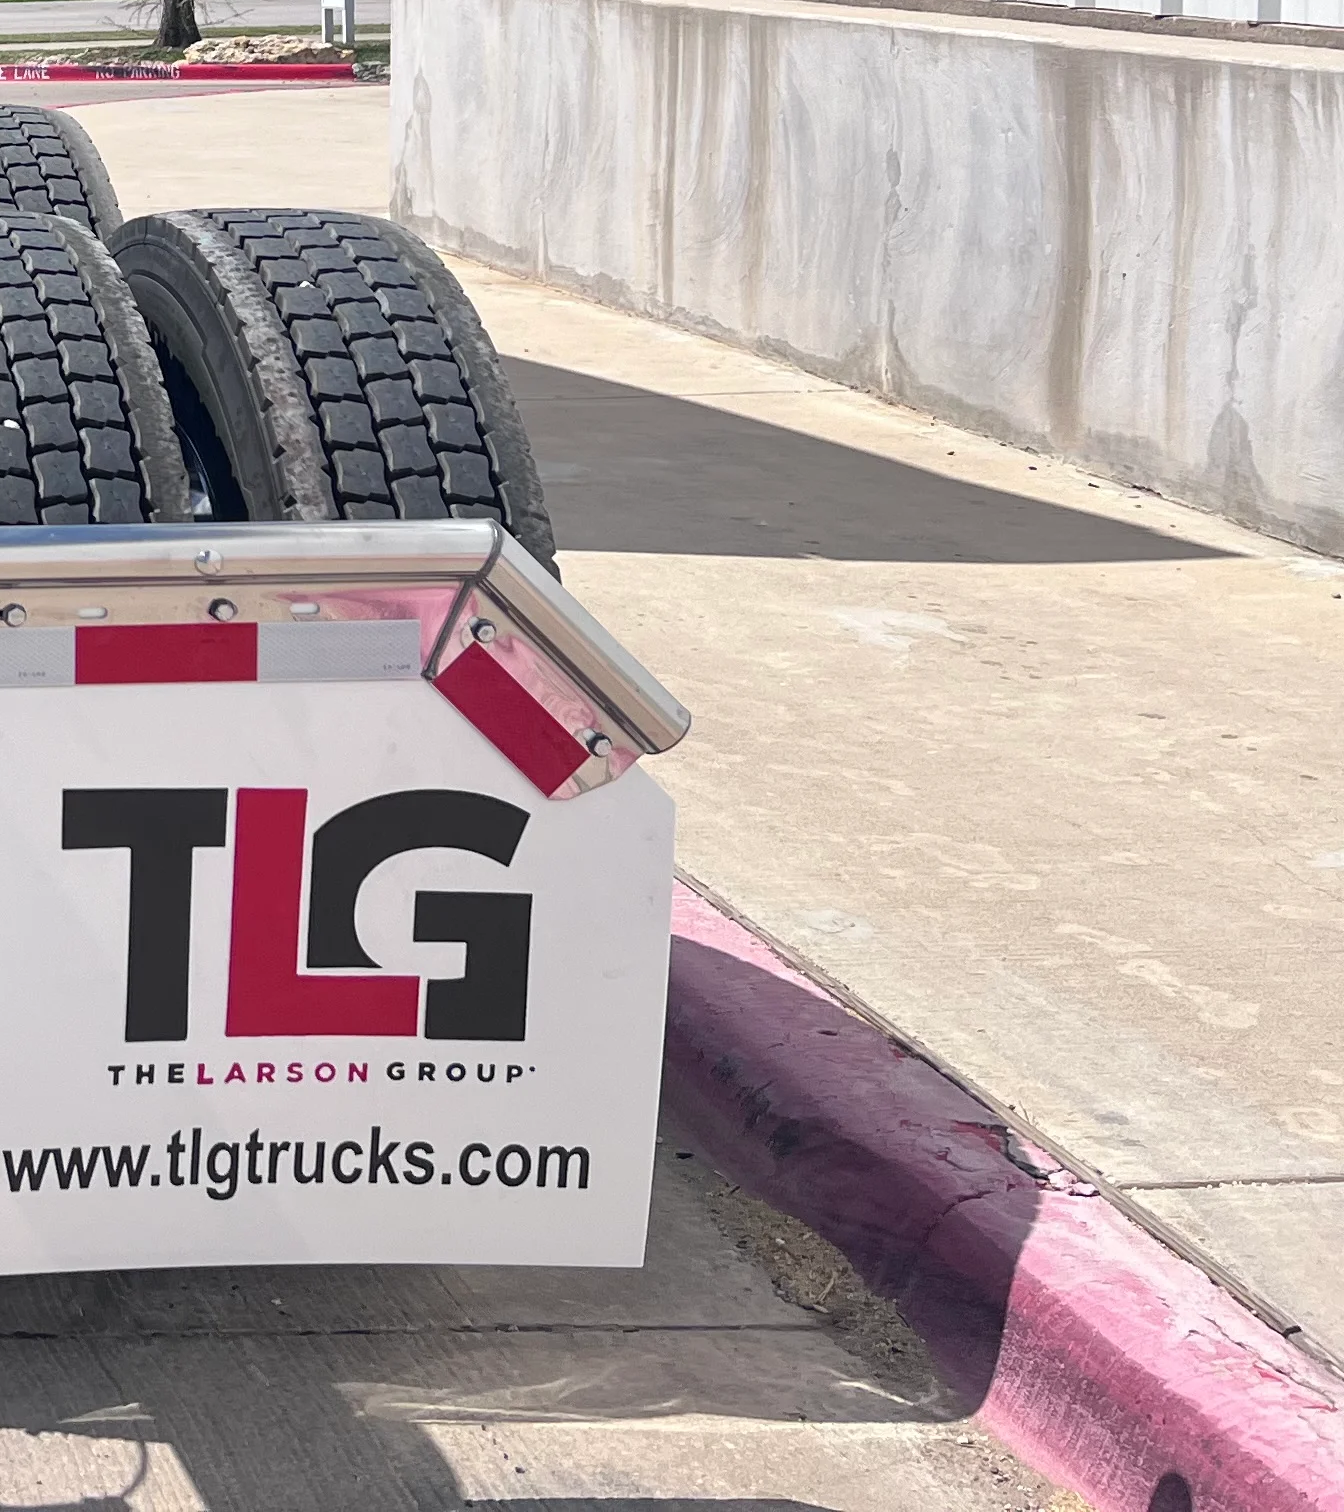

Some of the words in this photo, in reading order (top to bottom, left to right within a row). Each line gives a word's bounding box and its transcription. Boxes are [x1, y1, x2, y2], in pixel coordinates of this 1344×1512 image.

[14, 64, 50, 80] LANE
[62, 788, 532, 1042] TLG
[197, 1062, 369, 1084] LARSON
[387, 1061, 524, 1084] GROUP
[2, 1126, 589, 1200] www.tlgtrucks.com
